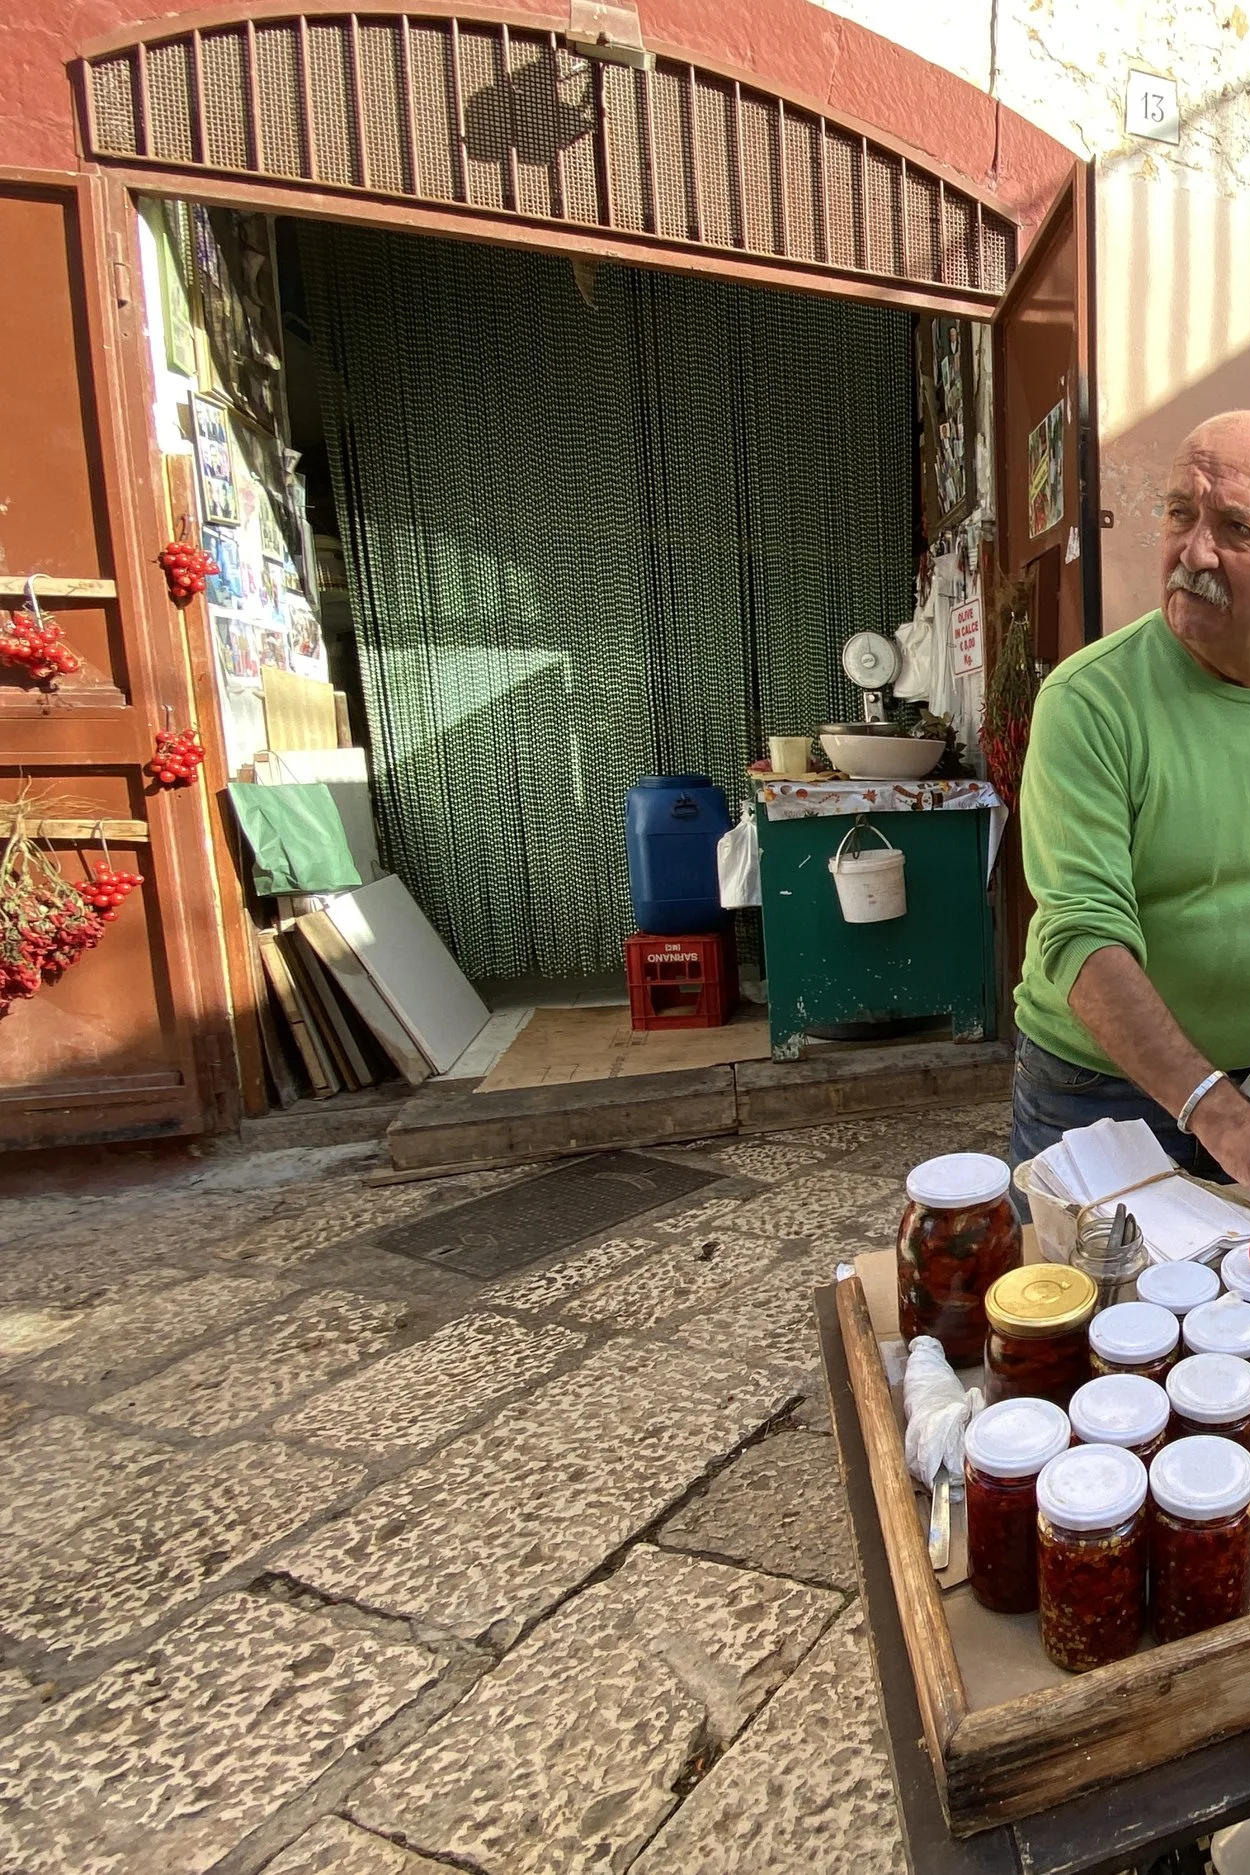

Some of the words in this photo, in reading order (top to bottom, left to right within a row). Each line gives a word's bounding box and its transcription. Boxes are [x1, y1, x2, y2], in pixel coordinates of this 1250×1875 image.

[1140, 92, 1164, 122] 13
[957, 608, 974, 624] OLIVE
[954, 628, 961, 639] IN
[961, 620, 979, 637] CALCE
[647, 952, 698, 963] SARNANO
